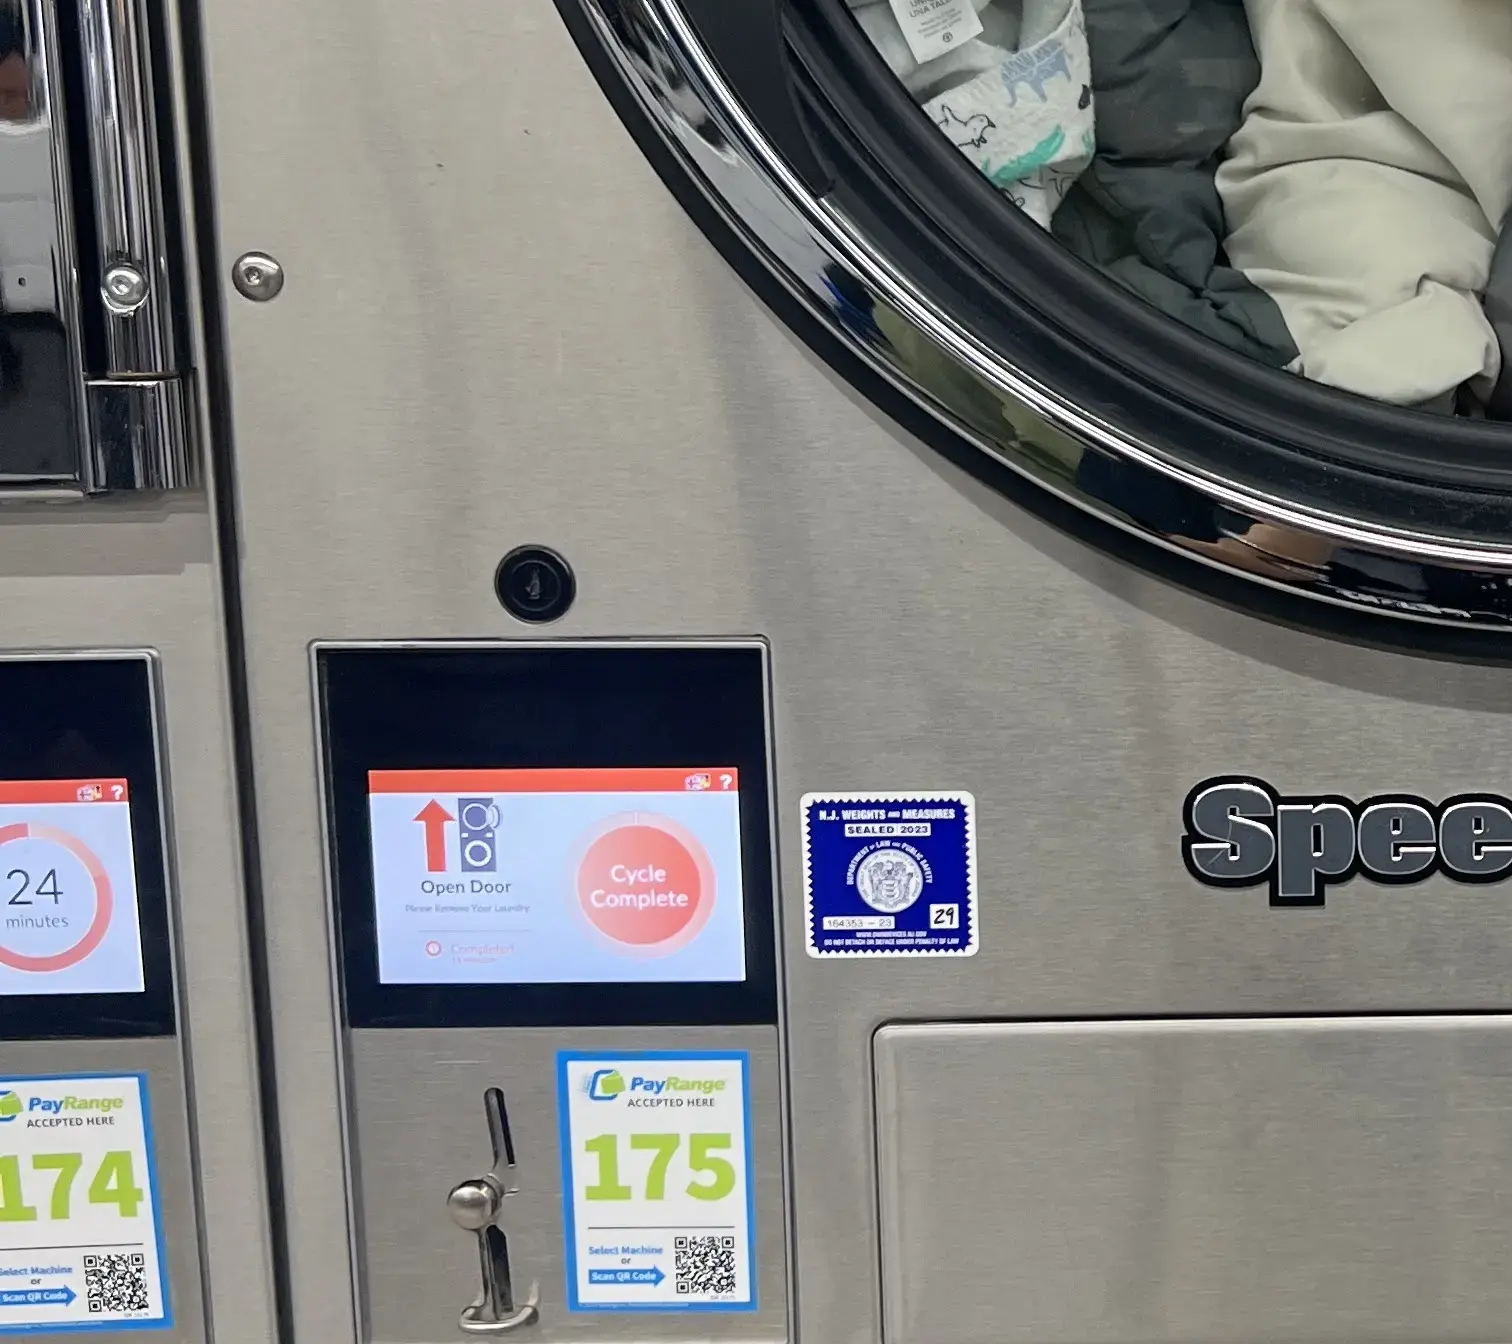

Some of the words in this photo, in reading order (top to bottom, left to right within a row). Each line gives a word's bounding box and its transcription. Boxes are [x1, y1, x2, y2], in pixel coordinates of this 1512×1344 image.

[909, 6, 930, 18] UNA
[819, 810, 839, 821] N.J.
[842, 809, 886, 821] WEIGHTS
[902, 809, 956, 819] MEASURES
[848, 826, 894, 834] SEALED
[900, 825, 928, 834] 2023
[610, 864, 667, 886] Cycle
[6, 868, 64, 906] 24
[421, 879, 465, 896] Open
[470, 880, 512, 894] Door
[591, 889, 689, 911] Complete
[471, 904, 492, 913] Your
[494, 904, 531, 914] Laundry
[6, 914, 69, 929] minutes
[878, 919, 892, 927] 23
[630, 1076, 725, 1094] PayRange
[29, 1096, 124, 1114] PayRange
[628, 1098, 683, 1107] ACCEPTED
[687, 1098, 715, 1107] HERE
[27, 1117, 83, 1128] ACCEPTED
[87, 1116, 115, 1126] HERE
[585, 1133, 736, 1201] 175
[0, 1151, 144, 1221] 174
[588, 1245, 619, 1255] Select
[621, 1245, 663, 1254] Machine
[621, 1256, 631, 1264] or
[30, 1265, 73, 1275] Machine
[30, 1277, 42, 1285] or
[591, 1272, 615, 1281] Scan
[616, 1272, 631, 1282] QR
[632, 1271, 656, 1281] Code
[2, 1292, 27, 1302] Scan
[43, 1291, 68, 1301] Code
